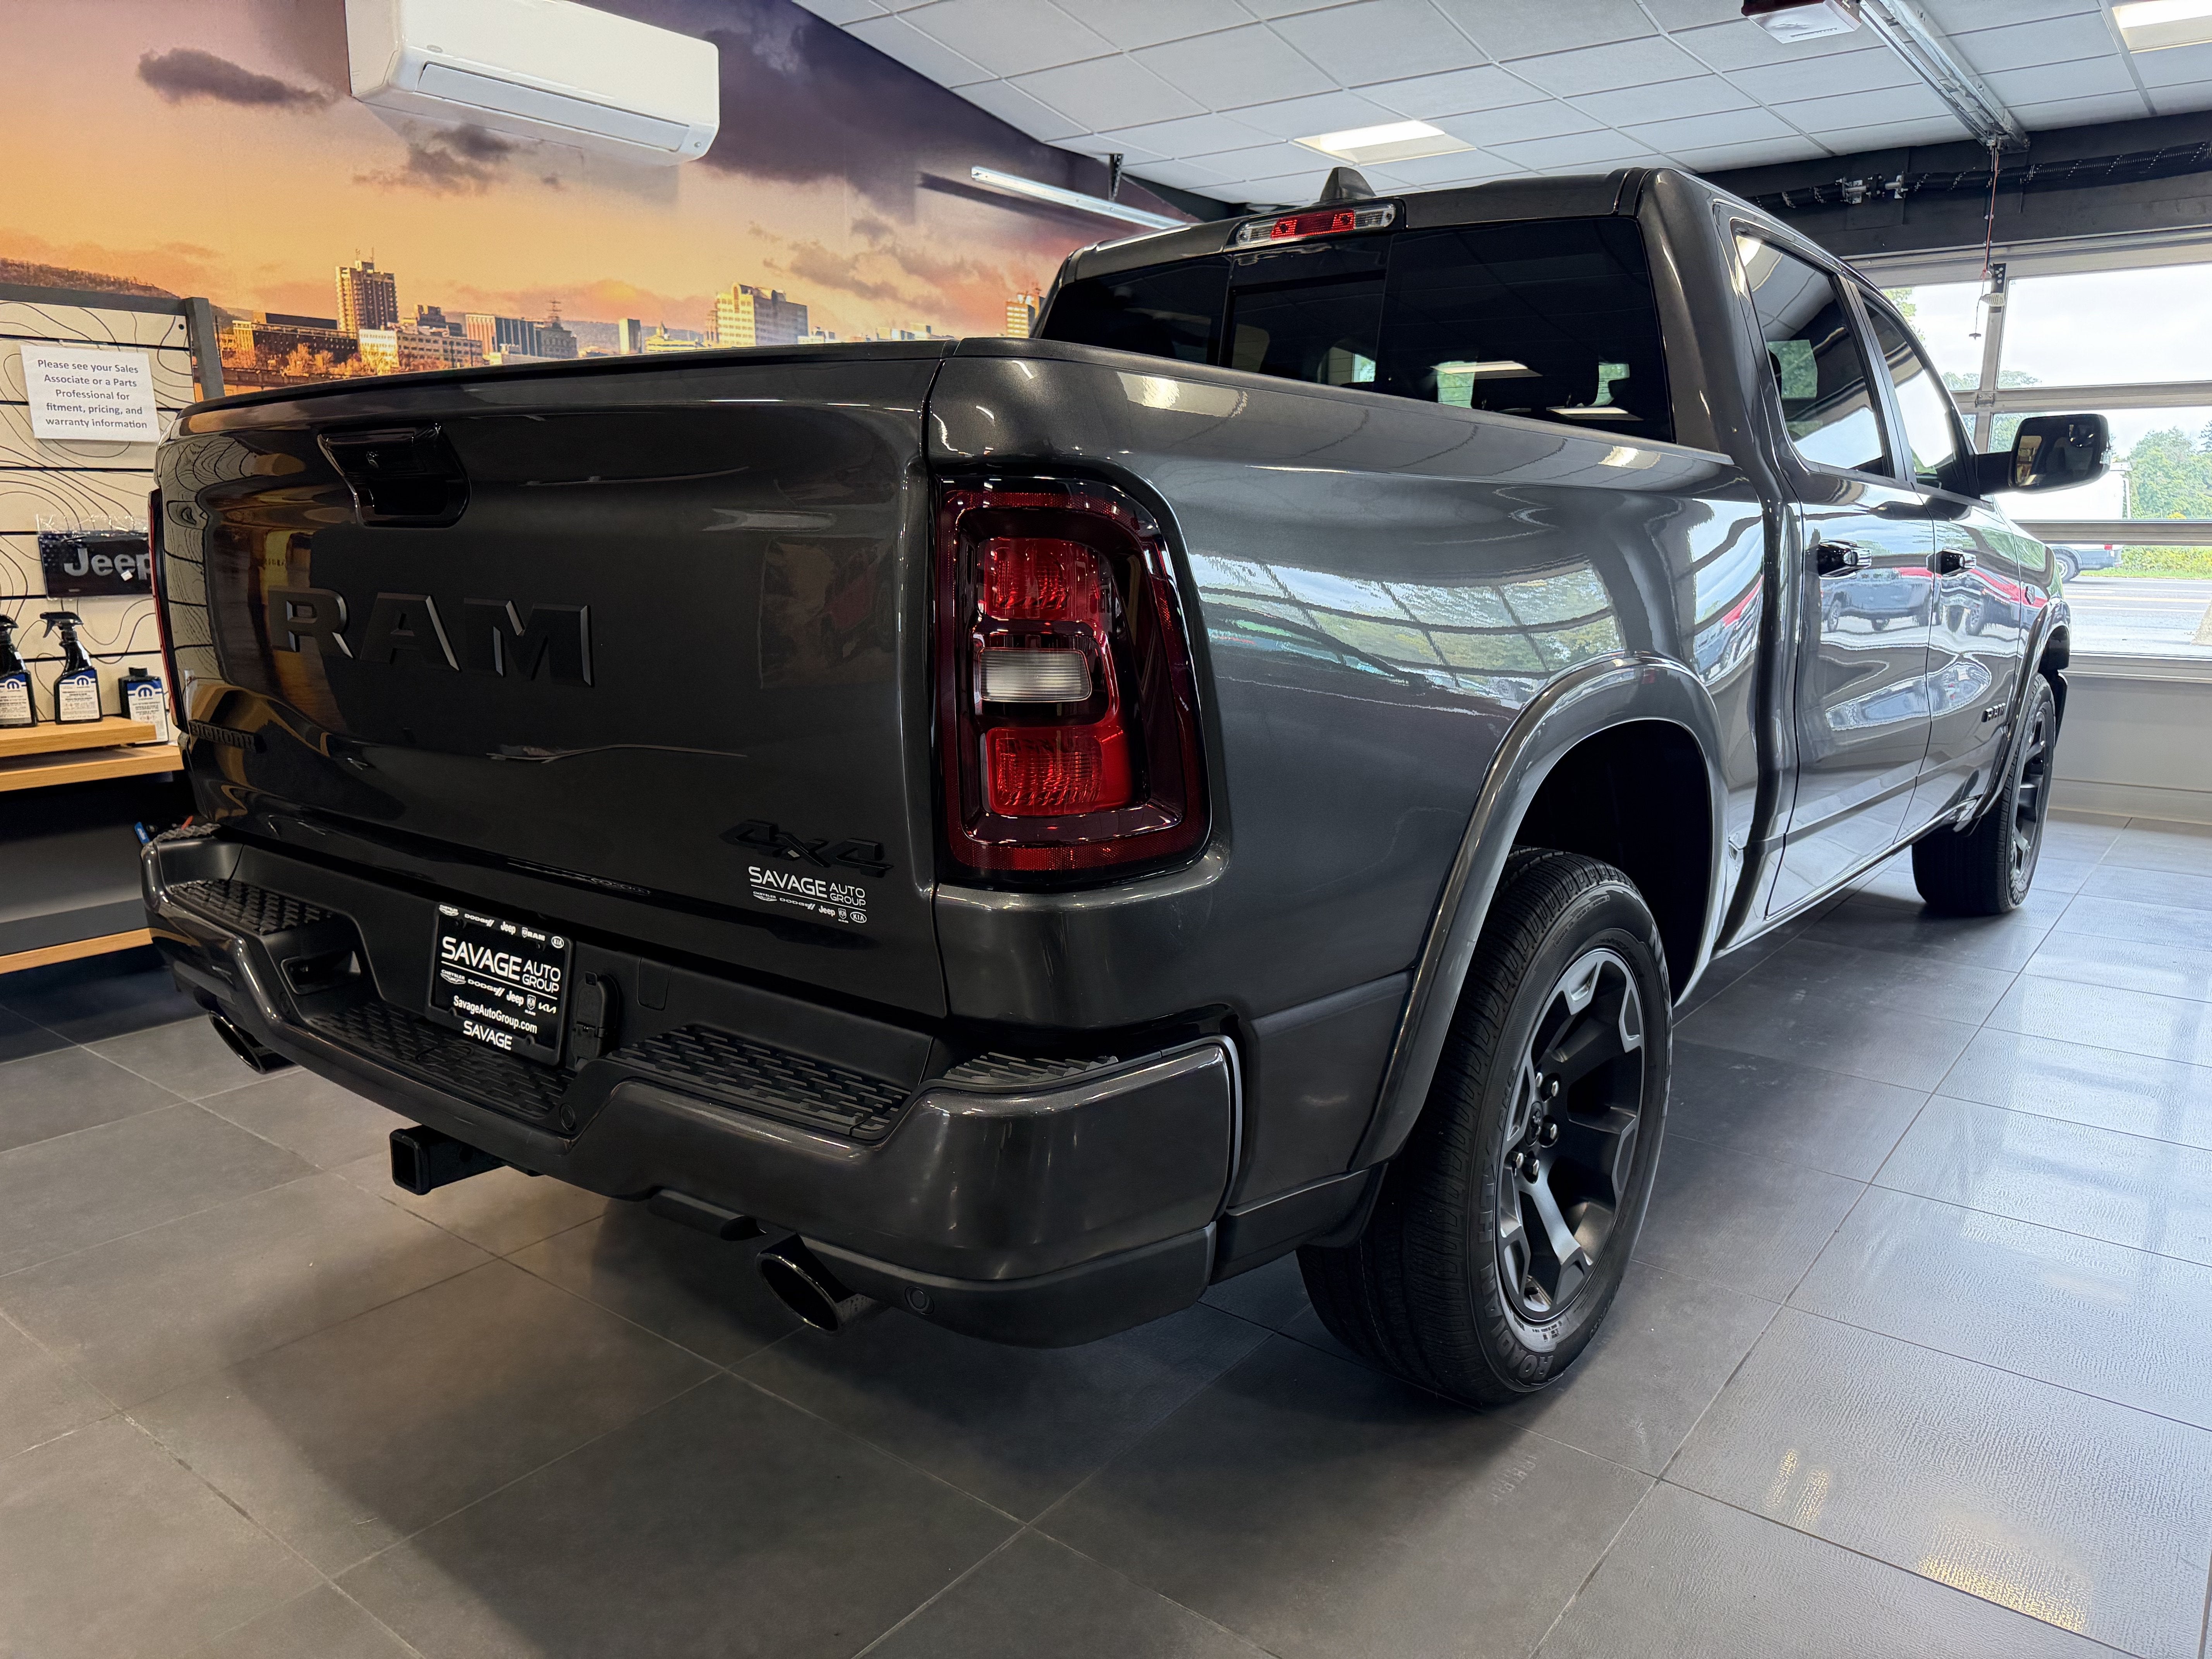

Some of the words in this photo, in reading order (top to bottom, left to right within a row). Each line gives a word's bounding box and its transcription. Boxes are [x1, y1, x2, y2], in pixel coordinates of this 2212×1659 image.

[38, 360, 69, 369] Please
[91, 364, 112, 372] your
[115, 365, 139, 374] Sales
[44, 374, 90, 384] Associate
[113, 378, 137, 387] Parts
[56, 389, 113, 400] Professional
[117, 392, 130, 400] for
[46, 403, 86, 413] fitment,
[89, 405, 123, 415] pricing,
[125, 407, 143, 415] and
[46, 419, 89, 428] warranty
[92, 419, 147, 428] information
[267, 586, 595, 687] RAM
[1982, 702, 2006, 722] RAM
[748, 866, 828, 898] SAVAGE
[830, 883, 865, 898] AUTO
[779, 897, 811, 908] DODGE
[818, 905, 835, 917] Jeep
[852, 914, 865, 922] KIA
[830, 893, 866, 907] GROUP
[500, 921, 516, 935] Jeep
[527, 931, 545, 941] RAM
[553, 938, 563, 947] KIA
[441, 936, 522, 981] SAVAGE
[523, 960, 561, 982] AUTO
[441, 969, 465, 980] CHRYSLER
[506, 990, 524, 1006] Jeep
[522, 974, 560, 993] GROUP
[453, 995, 537, 1034] SavageAutoGroup.com
[463, 1020, 513, 1051] SAVAGE
[1479, 1262, 1554, 1381] ROADIAN
